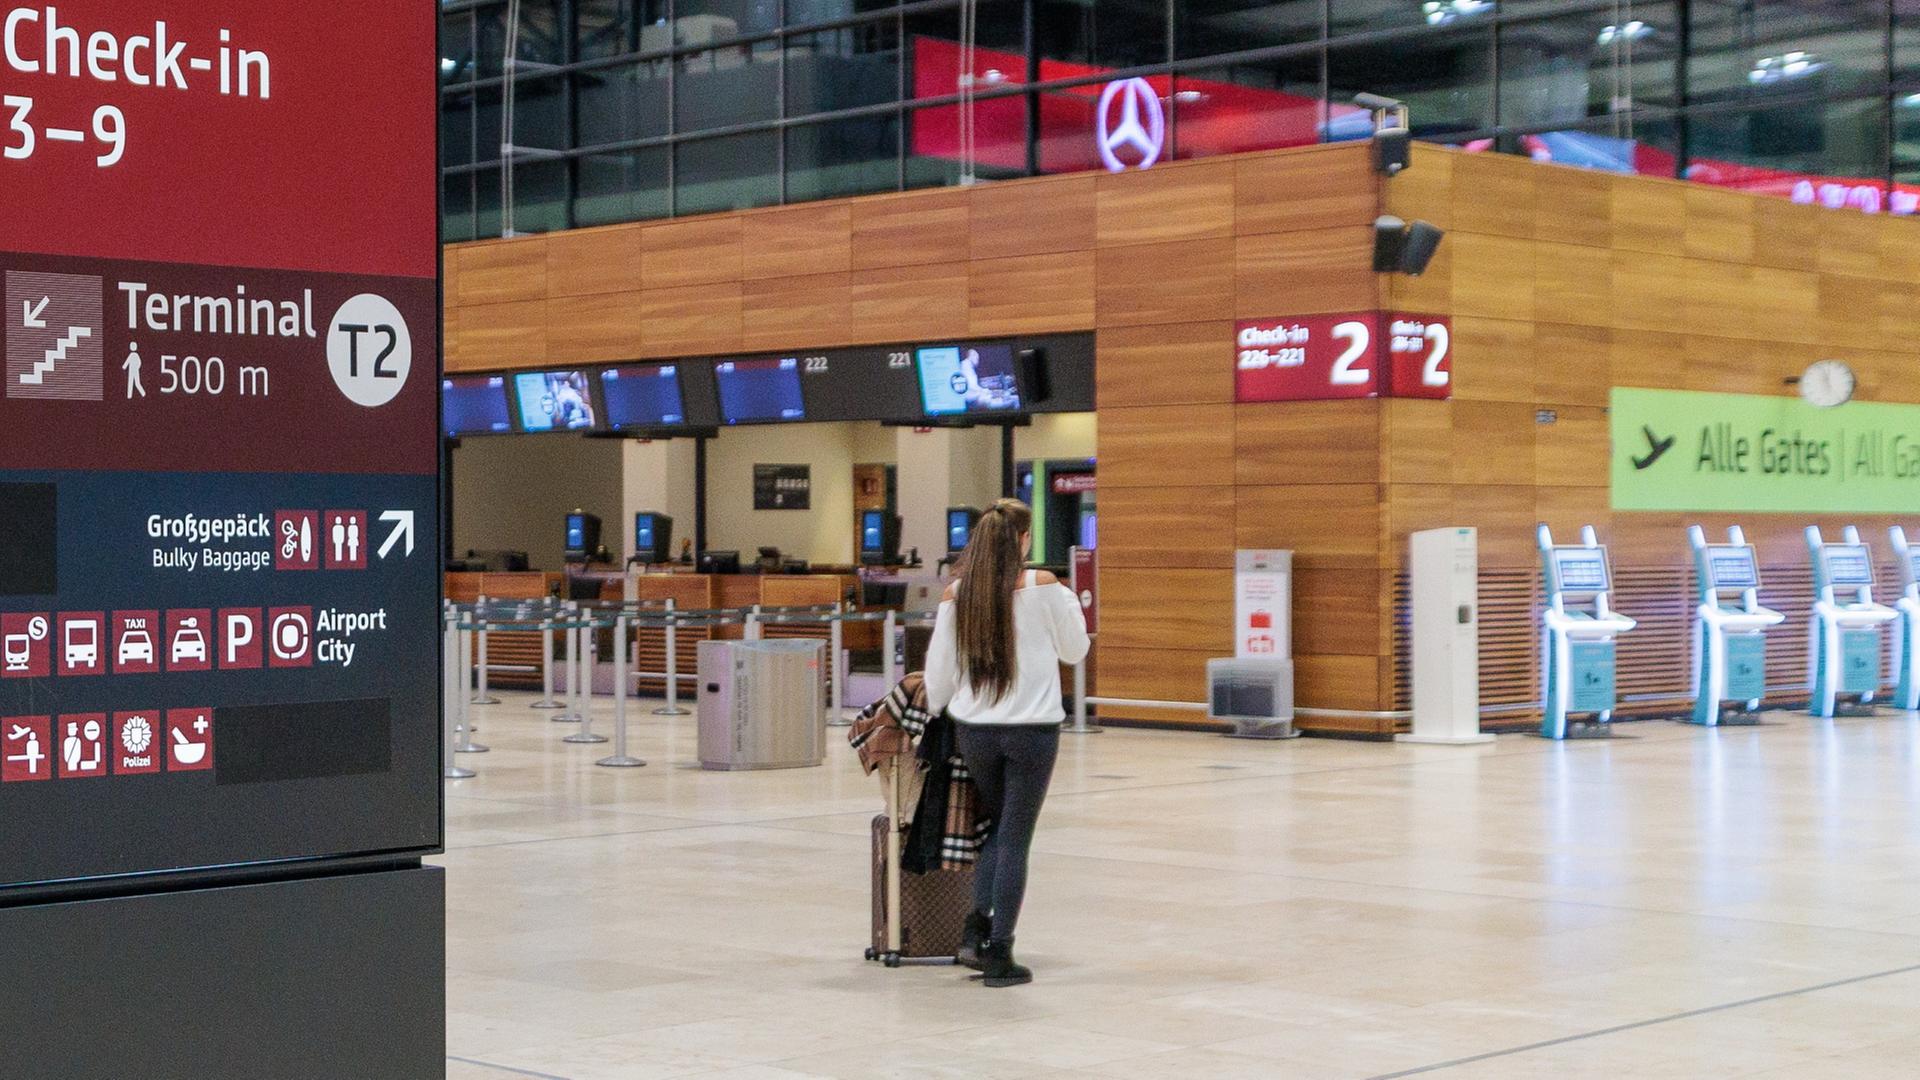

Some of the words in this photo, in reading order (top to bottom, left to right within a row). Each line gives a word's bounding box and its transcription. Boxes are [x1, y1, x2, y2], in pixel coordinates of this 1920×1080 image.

[4, 7, 270, 99] Check-in
[118, 281, 317, 338] Terminal
[1238, 324, 1309, 346] Check-in
[338, 323, 398, 379] T2
[804, 356, 829, 373] 222
[888, 352, 911, 369] 221
[1330, 321, 1370, 385] 2
[1421, 322, 1449, 386] 2
[160, 355, 225, 395] 500
[239, 366, 269, 396] m
[1697, 422, 1749, 473] Alle
[1760, 428, 1831, 475] Gates
[1854, 430, 1883, 476] All
[147, 513, 271, 543] Großgepäck
[153, 547, 198, 571] Bulky
[203, 548, 270, 572] Baggage
[32, 619, 44, 637] S
[124, 618, 146, 629] TAXI
[317, 607, 387, 633] Airport
[227, 614, 253, 663] P
[317, 638, 356, 667] City
[123, 756, 151, 767] Polizei
